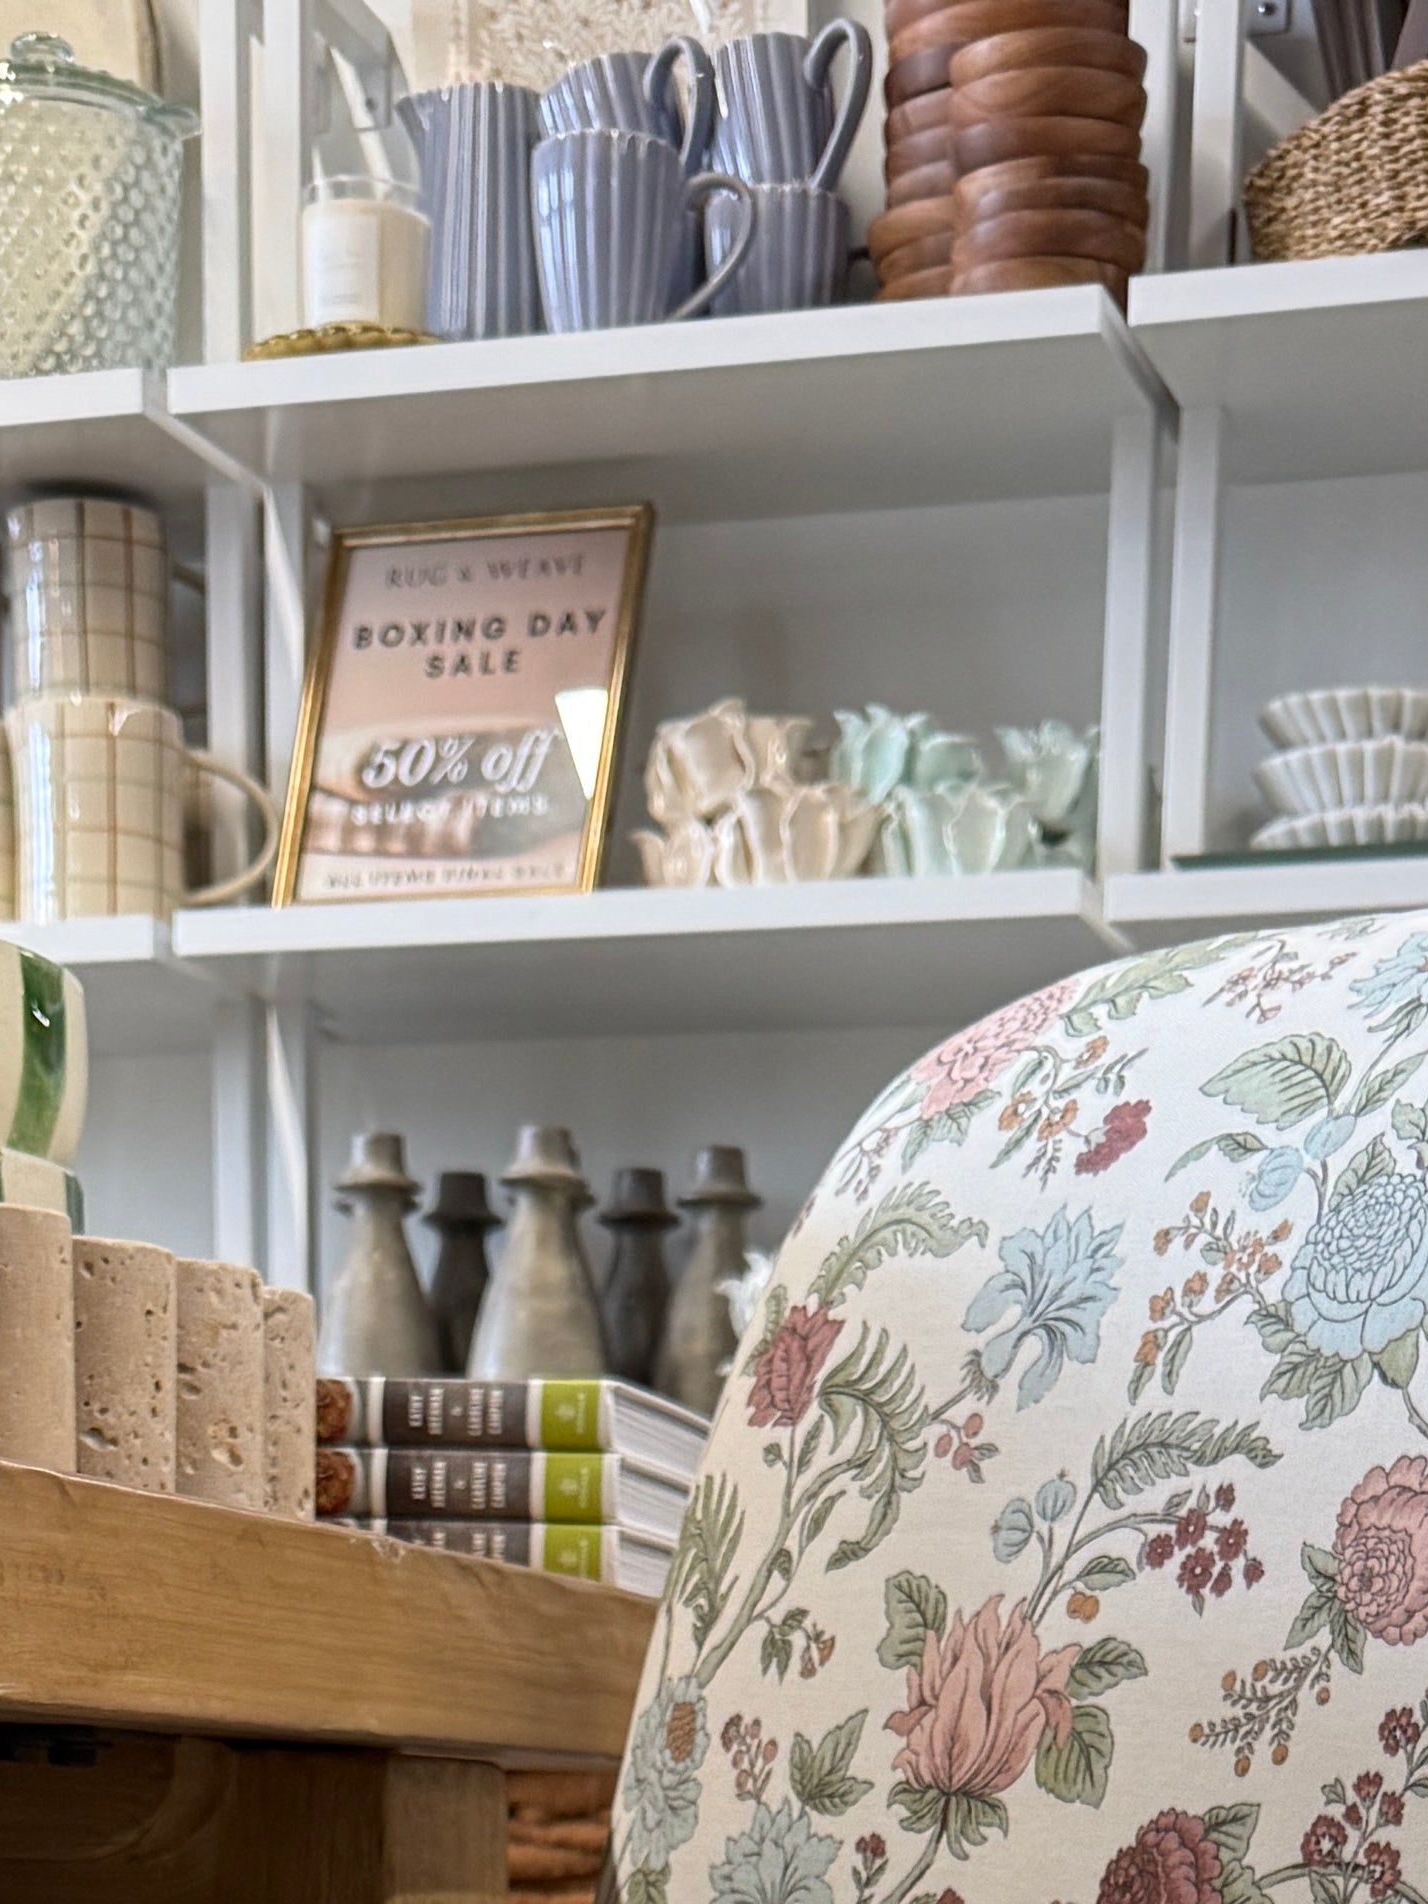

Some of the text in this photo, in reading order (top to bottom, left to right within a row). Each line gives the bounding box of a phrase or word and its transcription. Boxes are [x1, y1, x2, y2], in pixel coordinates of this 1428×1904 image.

[352, 607, 607, 651] BOXING DAY
[424, 650, 522, 679] SALE
[361, 726, 561, 794] 50% off
